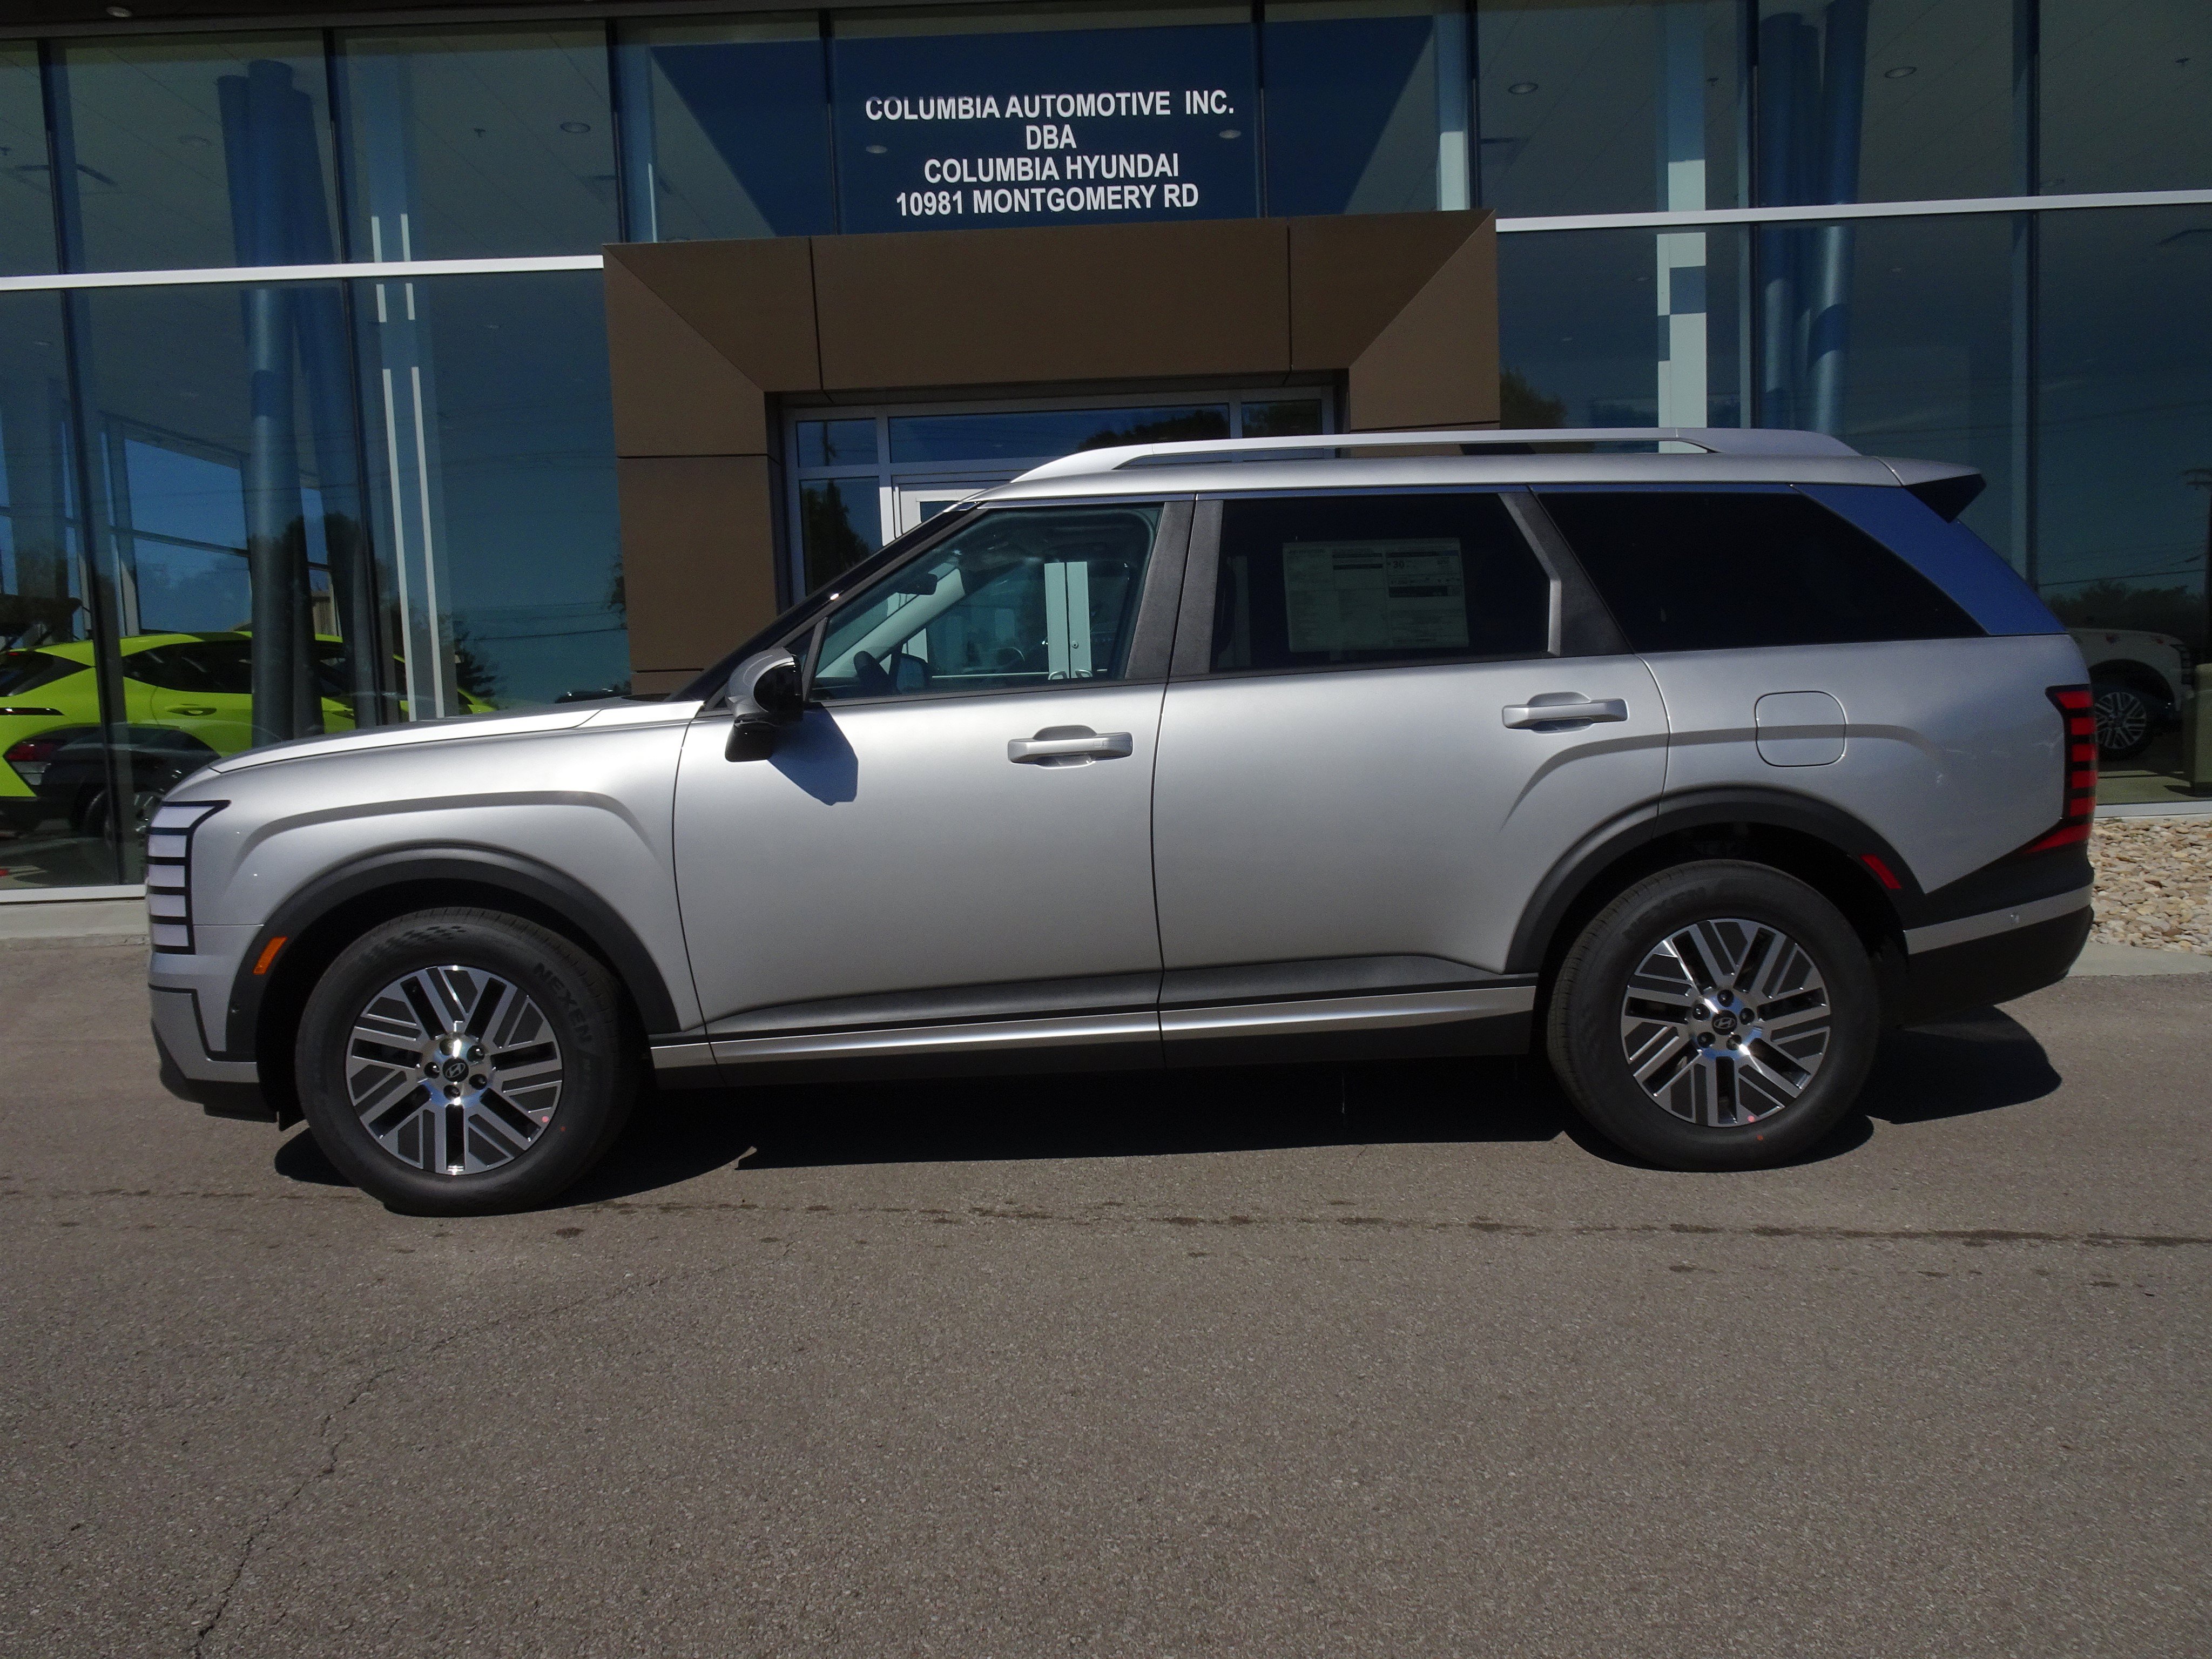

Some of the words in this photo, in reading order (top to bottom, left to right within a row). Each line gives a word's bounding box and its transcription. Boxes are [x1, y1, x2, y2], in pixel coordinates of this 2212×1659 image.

[866, 96, 1000, 120] COLUMBIA
[1005, 91, 1171, 118] AUTOMOTIVE
[1186, 90, 1234, 114] INC.
[1026, 124, 1077, 150] DBA
[925, 157, 1060, 184] COLUMBIA
[1067, 153, 1178, 180] HYUNDAI
[896, 191, 962, 216] 10981
[973, 185, 1157, 213] MONTGOMERY
[1164, 184, 1199, 208] RD
[534, 963, 592, 1043] NEXEN
